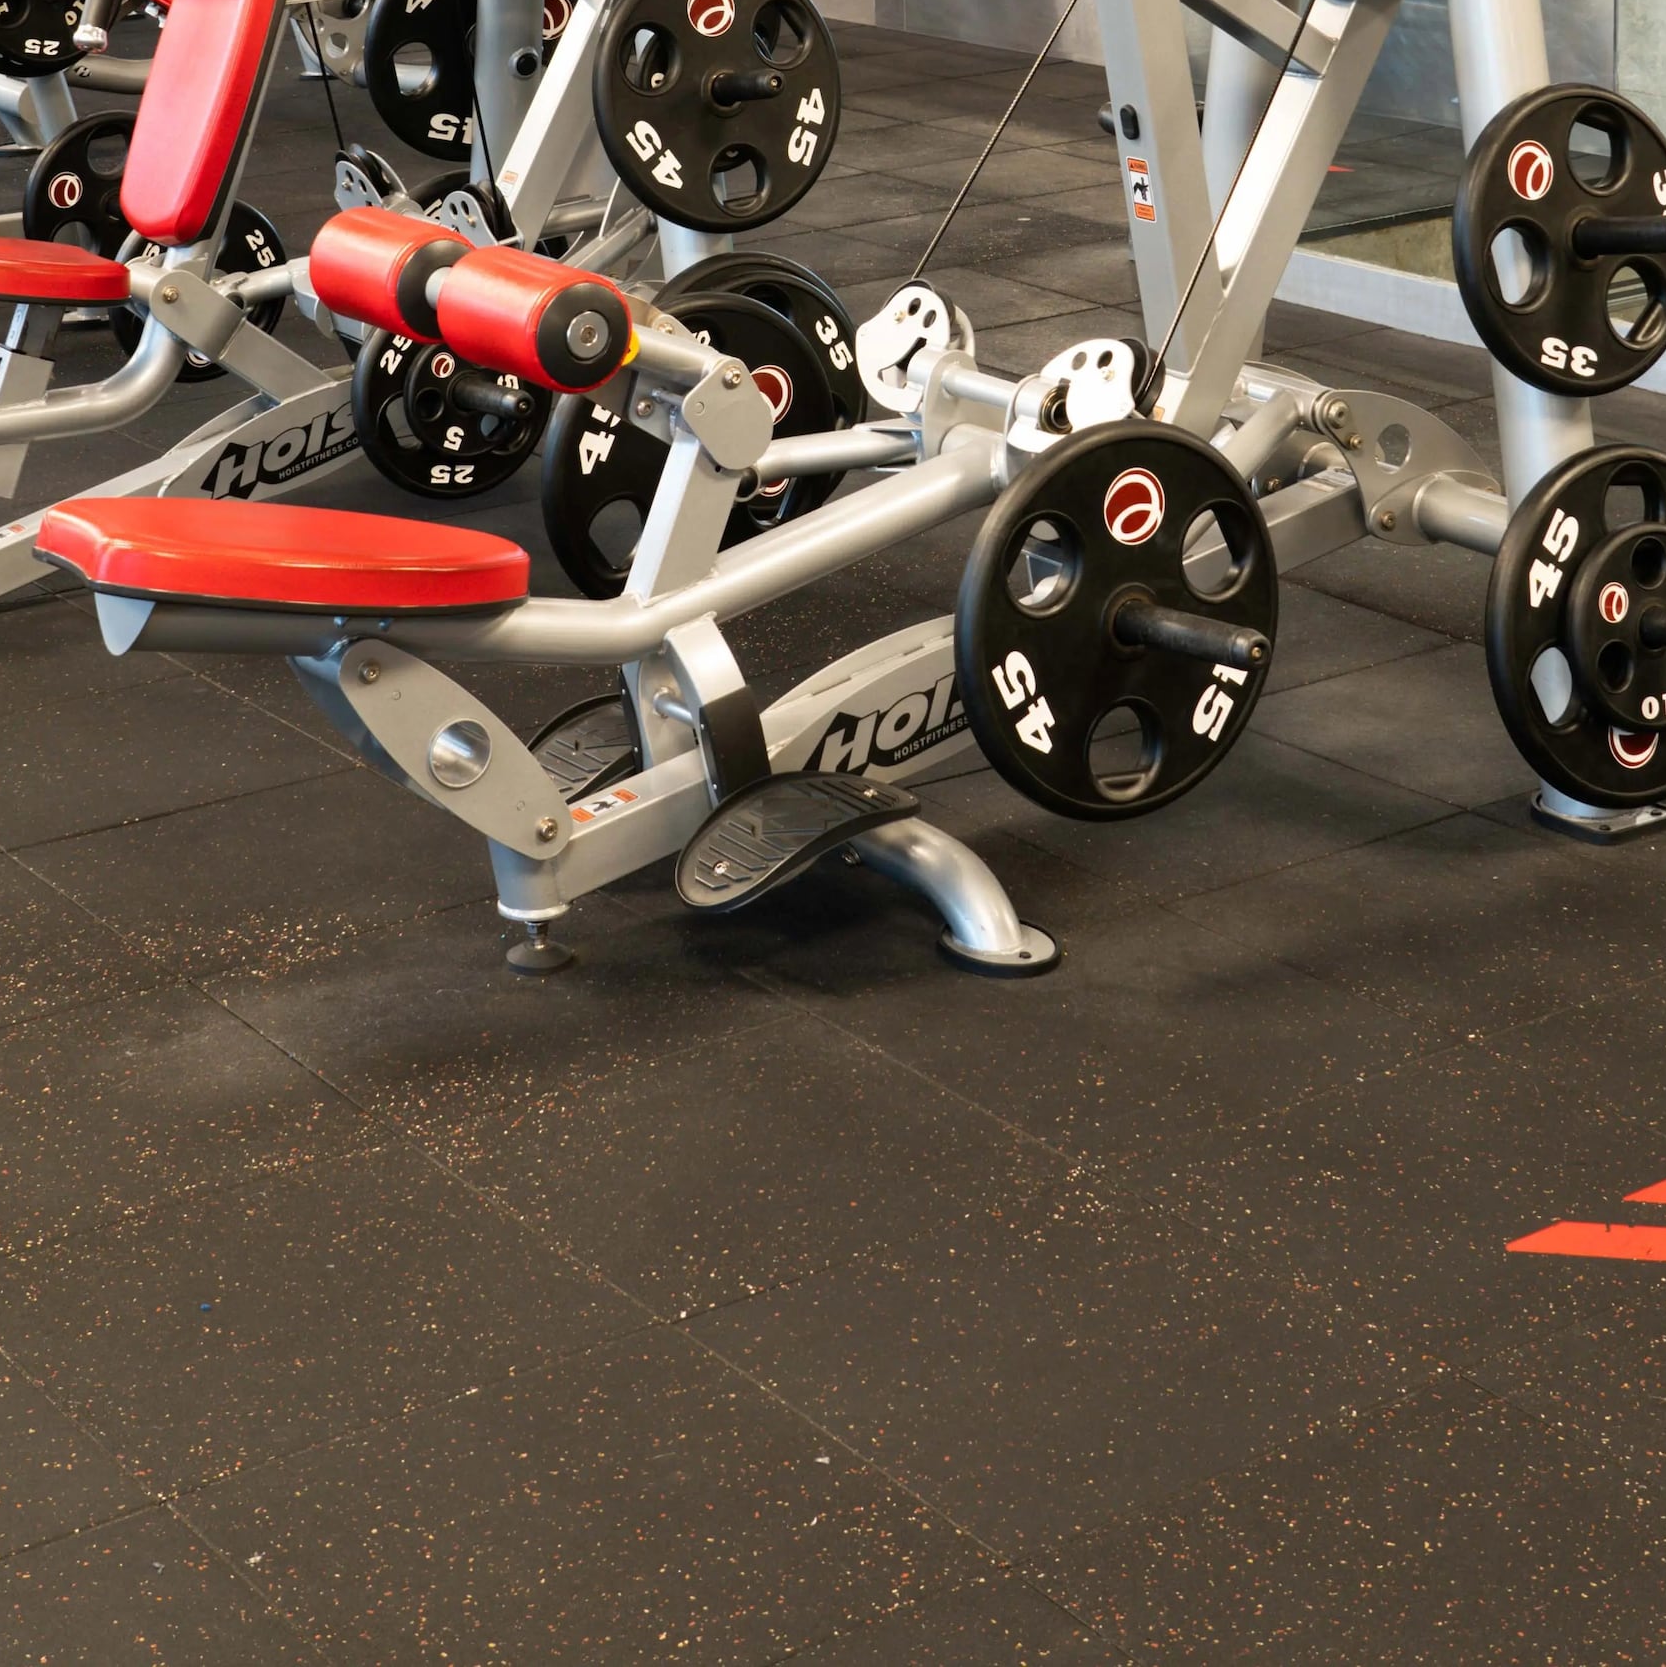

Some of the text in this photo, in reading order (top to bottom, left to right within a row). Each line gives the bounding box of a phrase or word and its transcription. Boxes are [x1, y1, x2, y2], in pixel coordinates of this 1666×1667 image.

[24, 38, 61, 55] 25
[626, 120, 684, 190] 45
[787, 88, 826, 166] 45
[244, 229, 276, 269] 25
[815, 315, 854, 371] 35
[1541, 336, 1598, 378] 35
[211, 402, 359, 500] HOIS
[278, 436, 360, 480] HOISTFITNESS.CO
[443, 425, 465, 451] 5
[430, 463, 475, 485] 25
[1528, 507, 1580, 608] 45
[819, 672, 966, 774] HOI
[991, 650, 1056, 754] 45
